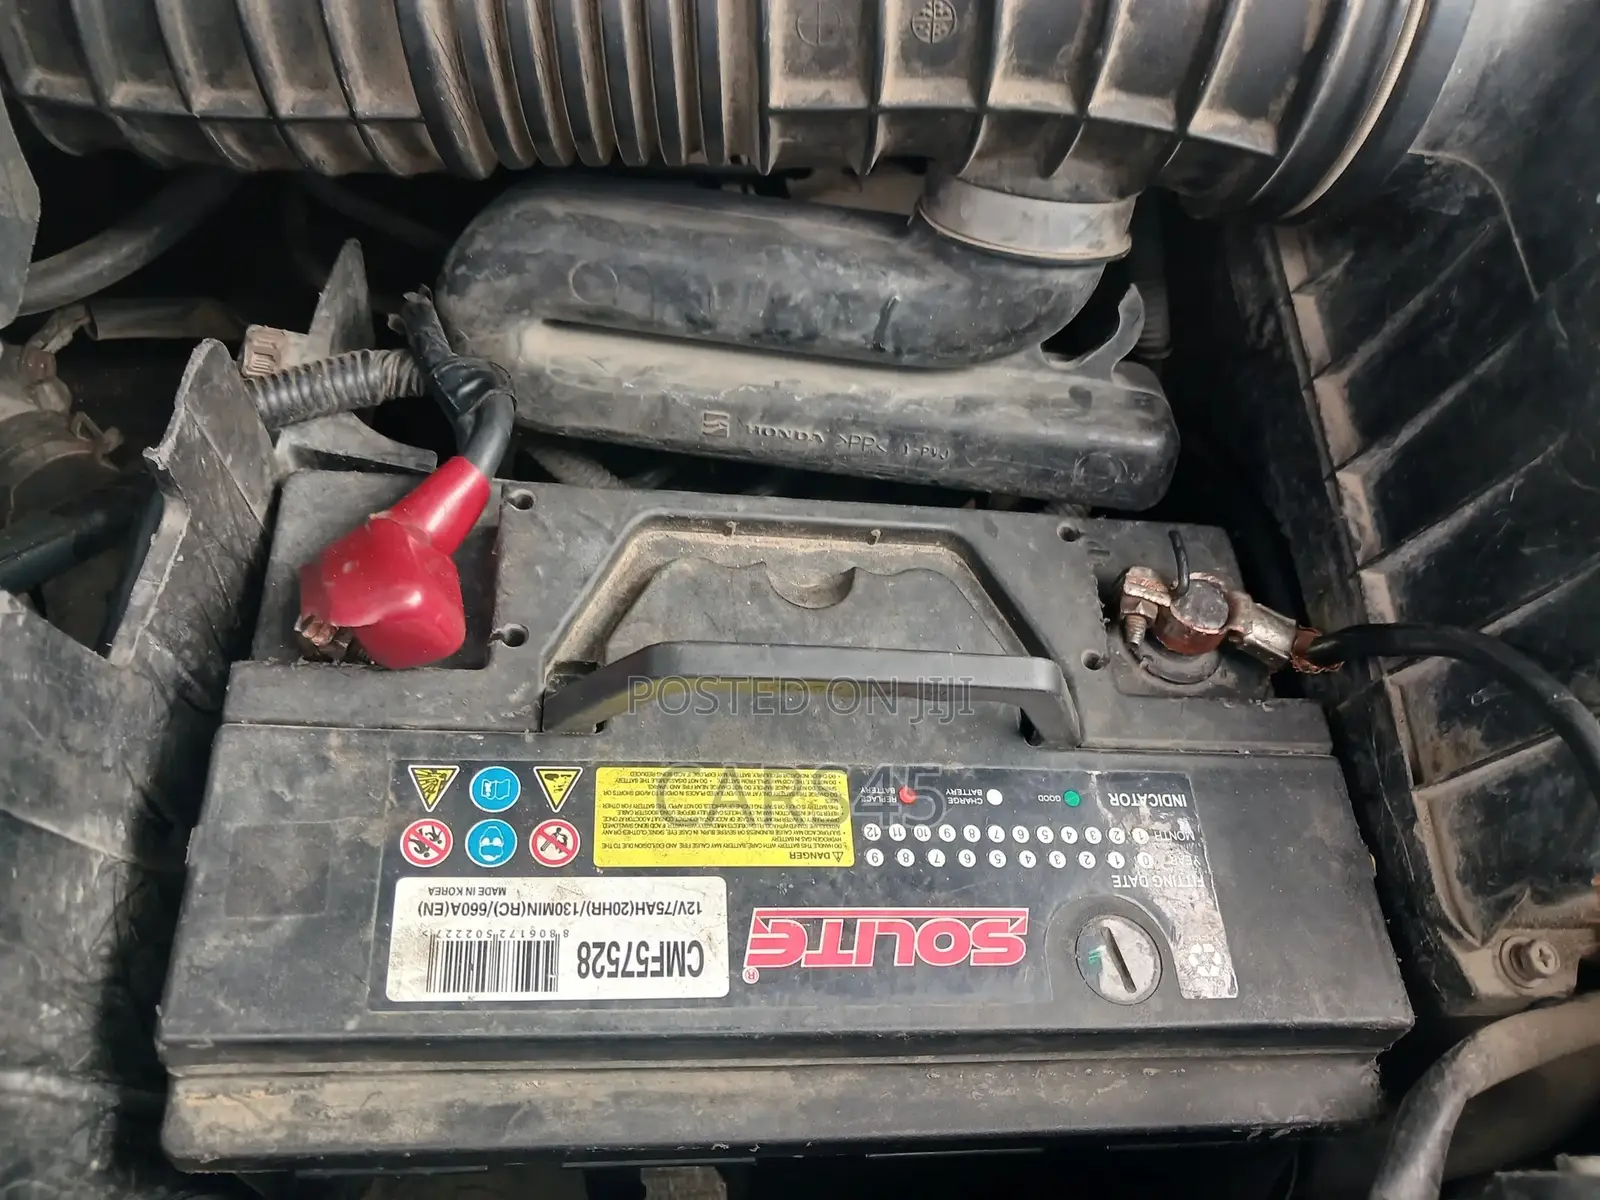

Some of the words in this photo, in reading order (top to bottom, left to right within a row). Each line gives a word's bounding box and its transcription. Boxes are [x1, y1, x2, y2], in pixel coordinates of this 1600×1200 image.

[746, 425, 824, 442] HONDA
[946, 788, 982, 796] BATTERY
[861, 795, 896, 803] REPLACE
[1108, 793, 1187, 807] INDICATOR
[1154, 831, 1195, 840] MONTH
[1112, 875, 1148, 887] DATE
[1152, 875, 1205, 887] FITTING
[428, 887, 463, 896] KOREA
[466, 887, 475, 896] IN
[478, 887, 506, 896] MADE
[418, 900, 702, 917] 12V/75AH(20HR)/130MIN(RC)/660A(EN)
[743, 912, 1028, 967] SOLITE
[577, 941, 704, 979] CMF57528
